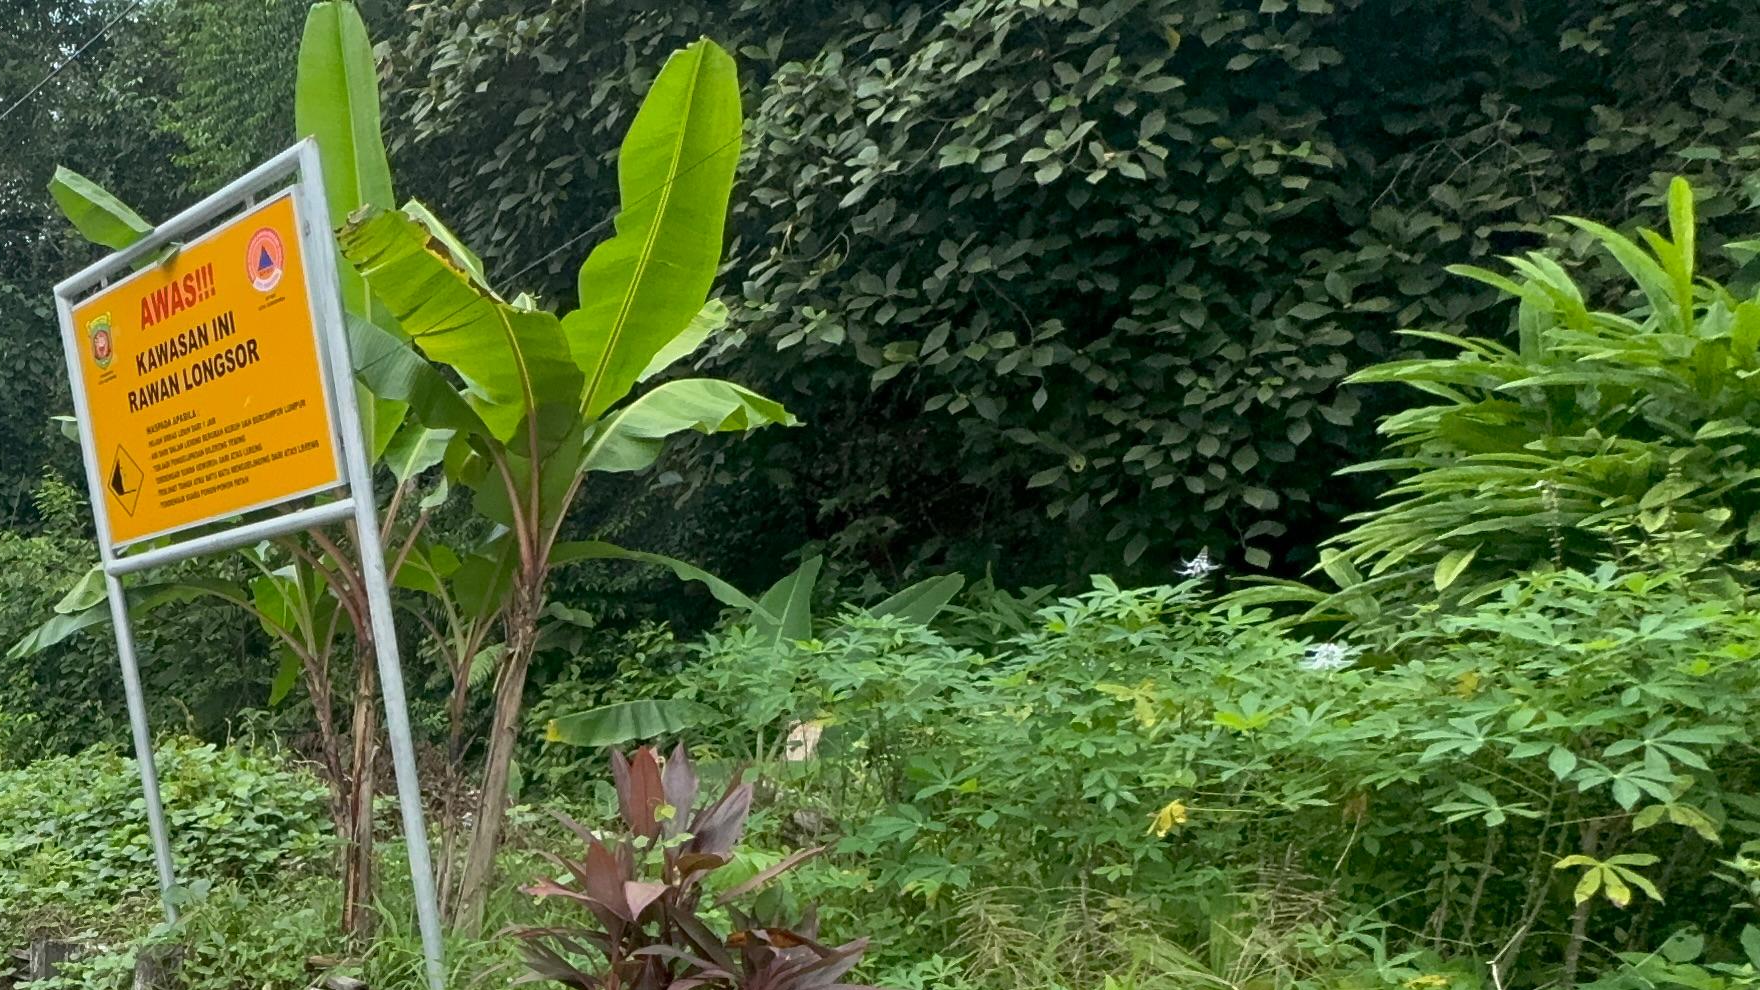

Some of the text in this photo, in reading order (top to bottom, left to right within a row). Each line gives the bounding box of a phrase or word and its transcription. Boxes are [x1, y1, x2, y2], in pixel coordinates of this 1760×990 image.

[141, 263, 216, 331] AWAS!!!
[128, 338, 261, 414] RAWAN LONGSOR
[135, 322, 210, 377] KAWASAN
[212, 311, 236, 342] INI
